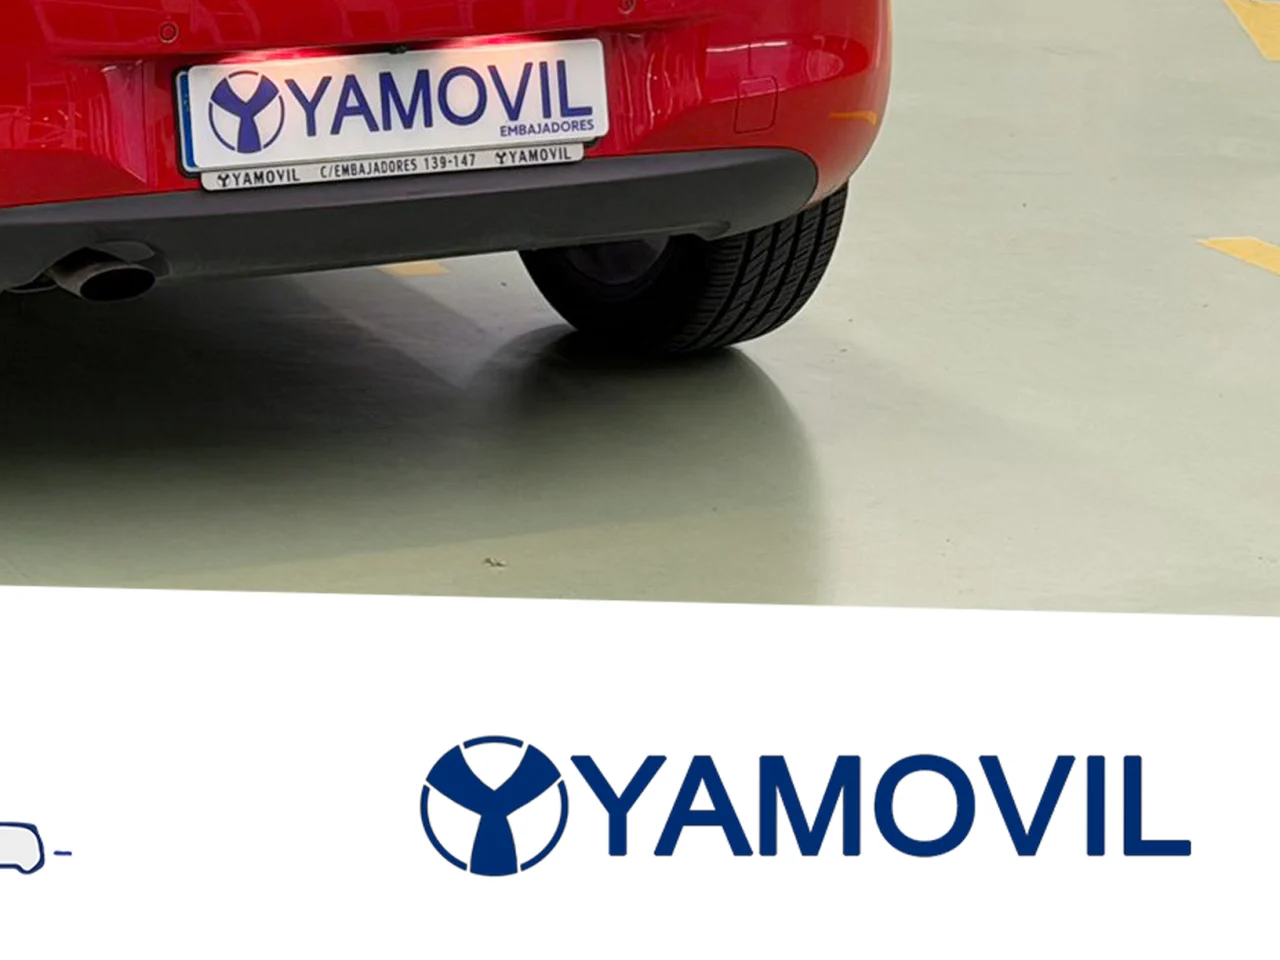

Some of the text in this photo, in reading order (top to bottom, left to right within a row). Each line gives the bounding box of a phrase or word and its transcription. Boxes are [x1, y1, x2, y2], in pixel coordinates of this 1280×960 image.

[284, 59, 594, 138] YAMOVIL
[499, 118, 596, 138] EMBAJADORES
[233, 146, 572, 187] YAMOVIL C/EMBAJADORES 139-147 YAMOVIL
